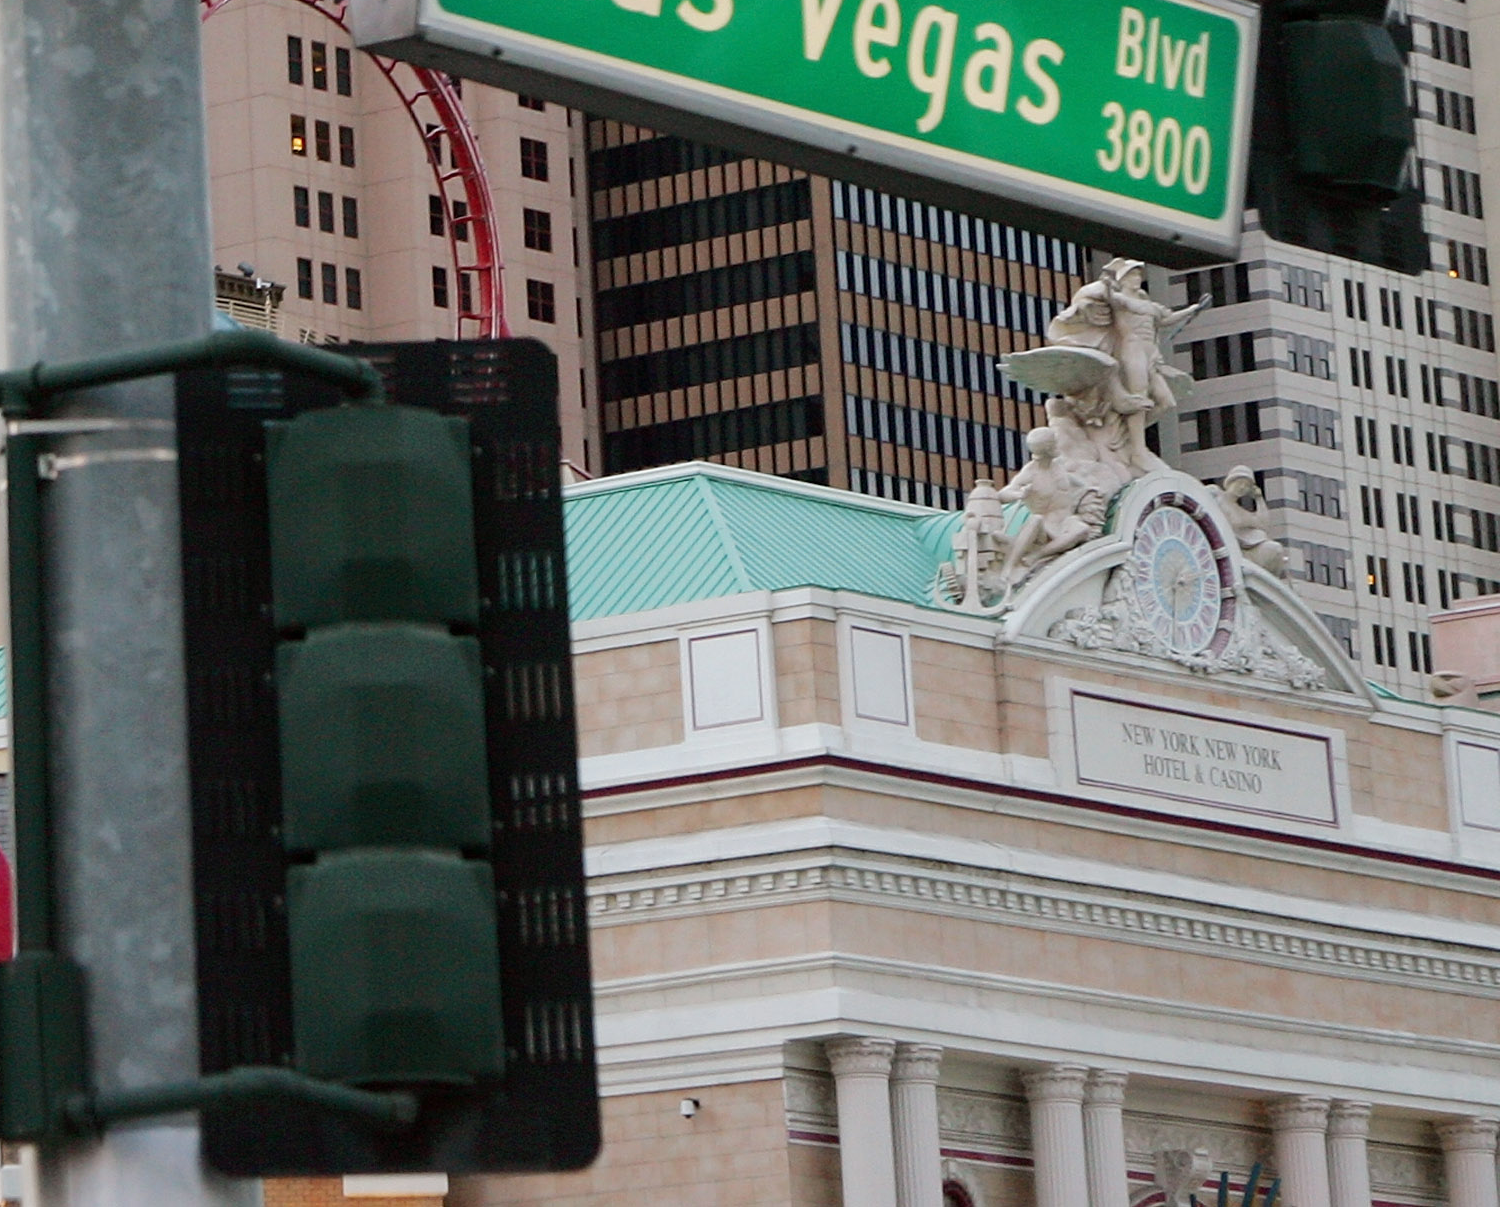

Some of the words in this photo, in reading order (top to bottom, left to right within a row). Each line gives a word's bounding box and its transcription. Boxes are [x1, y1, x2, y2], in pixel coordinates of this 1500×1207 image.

[1116, 5, 1211, 99] Blvd
[1095, 101, 1212, 196] 3800
[1122, 722, 1157, 746] NEW
[1160, 729, 1200, 756] YORK
[1204, 738, 1238, 761] NEW
[1242, 744, 1283, 771] YORK
[1143, 753, 1191, 782] HOTEL
[1195, 764, 1205, 784] &
[1209, 766, 1263, 794] CASINO
